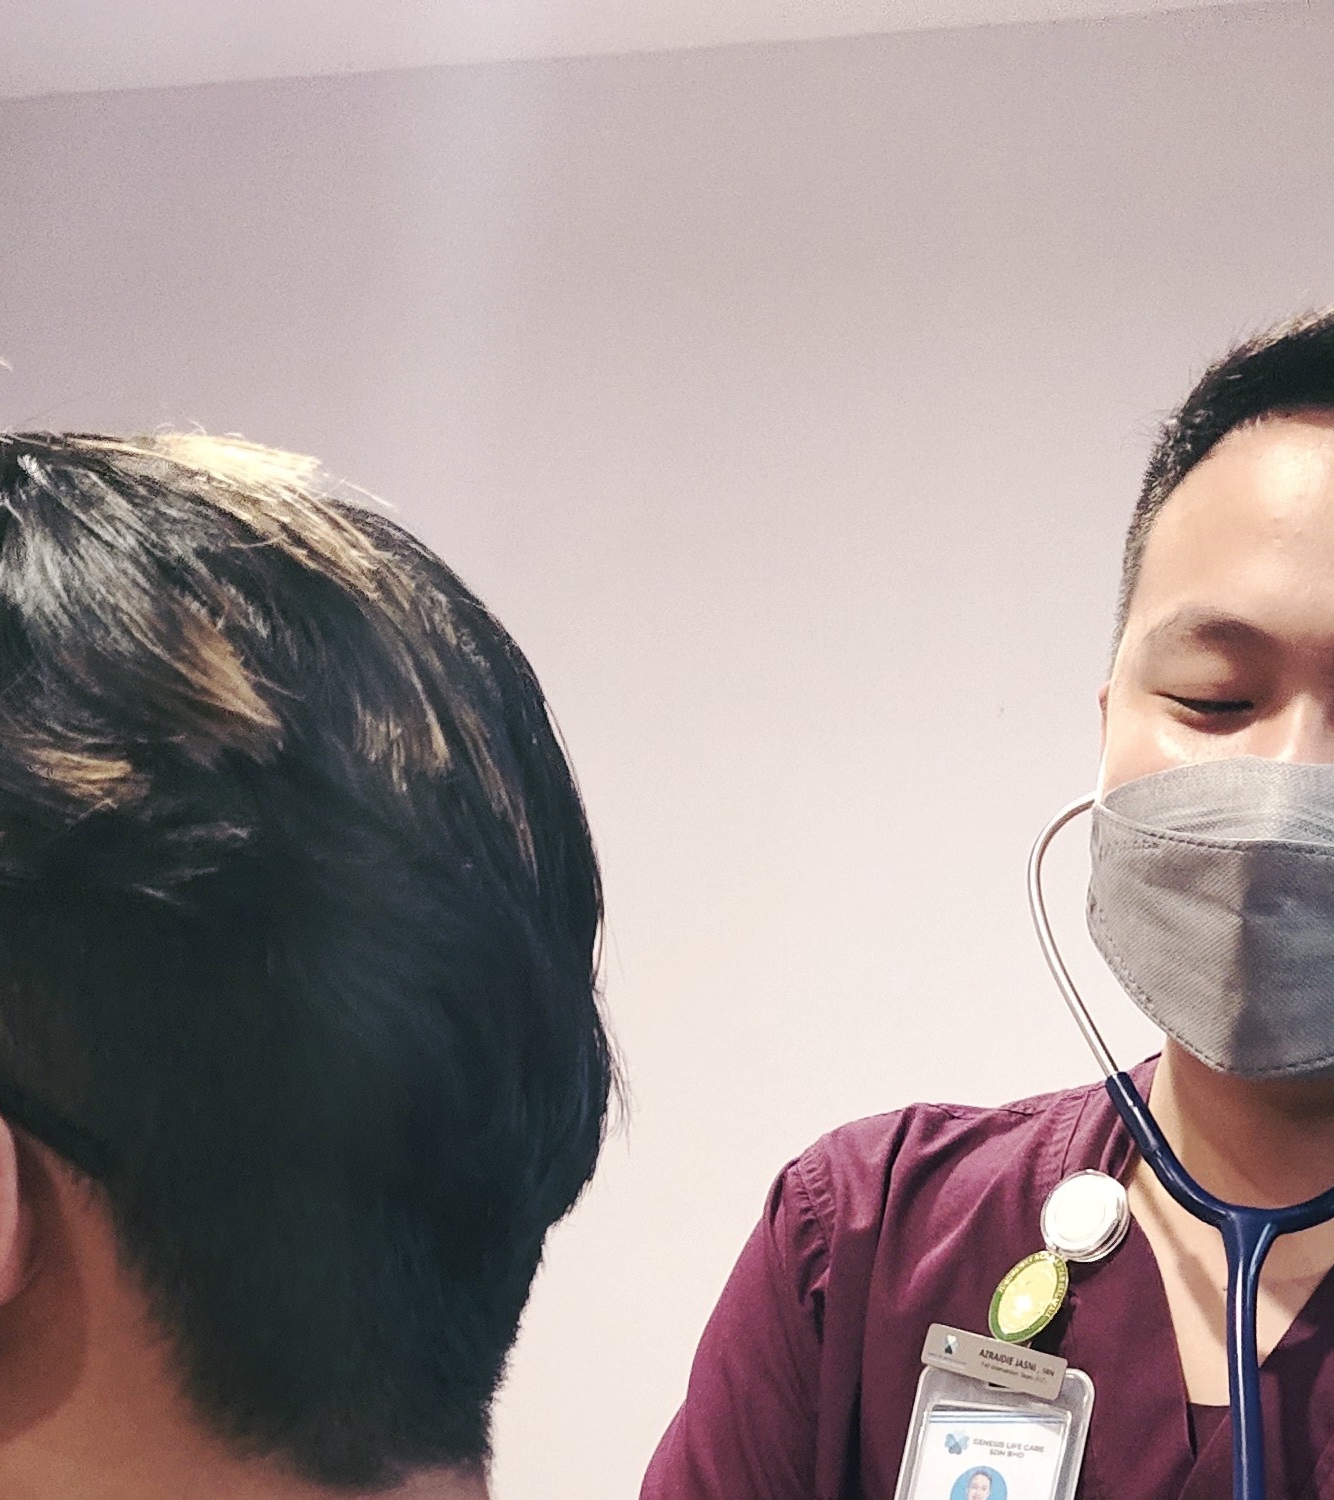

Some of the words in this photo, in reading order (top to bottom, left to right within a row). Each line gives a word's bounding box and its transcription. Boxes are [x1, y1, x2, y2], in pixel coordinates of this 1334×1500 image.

[979, 1348, 1014, 1366] AZRAIDIE
[973, 1438, 1004, 1448] GENESIS
[1006, 1441, 1022, 1450] LIFE
[1023, 1443, 1044, 1453] CARE
[989, 1448, 1005, 1456] SDN
[1007, 1450, 1024, 1458] BHD
